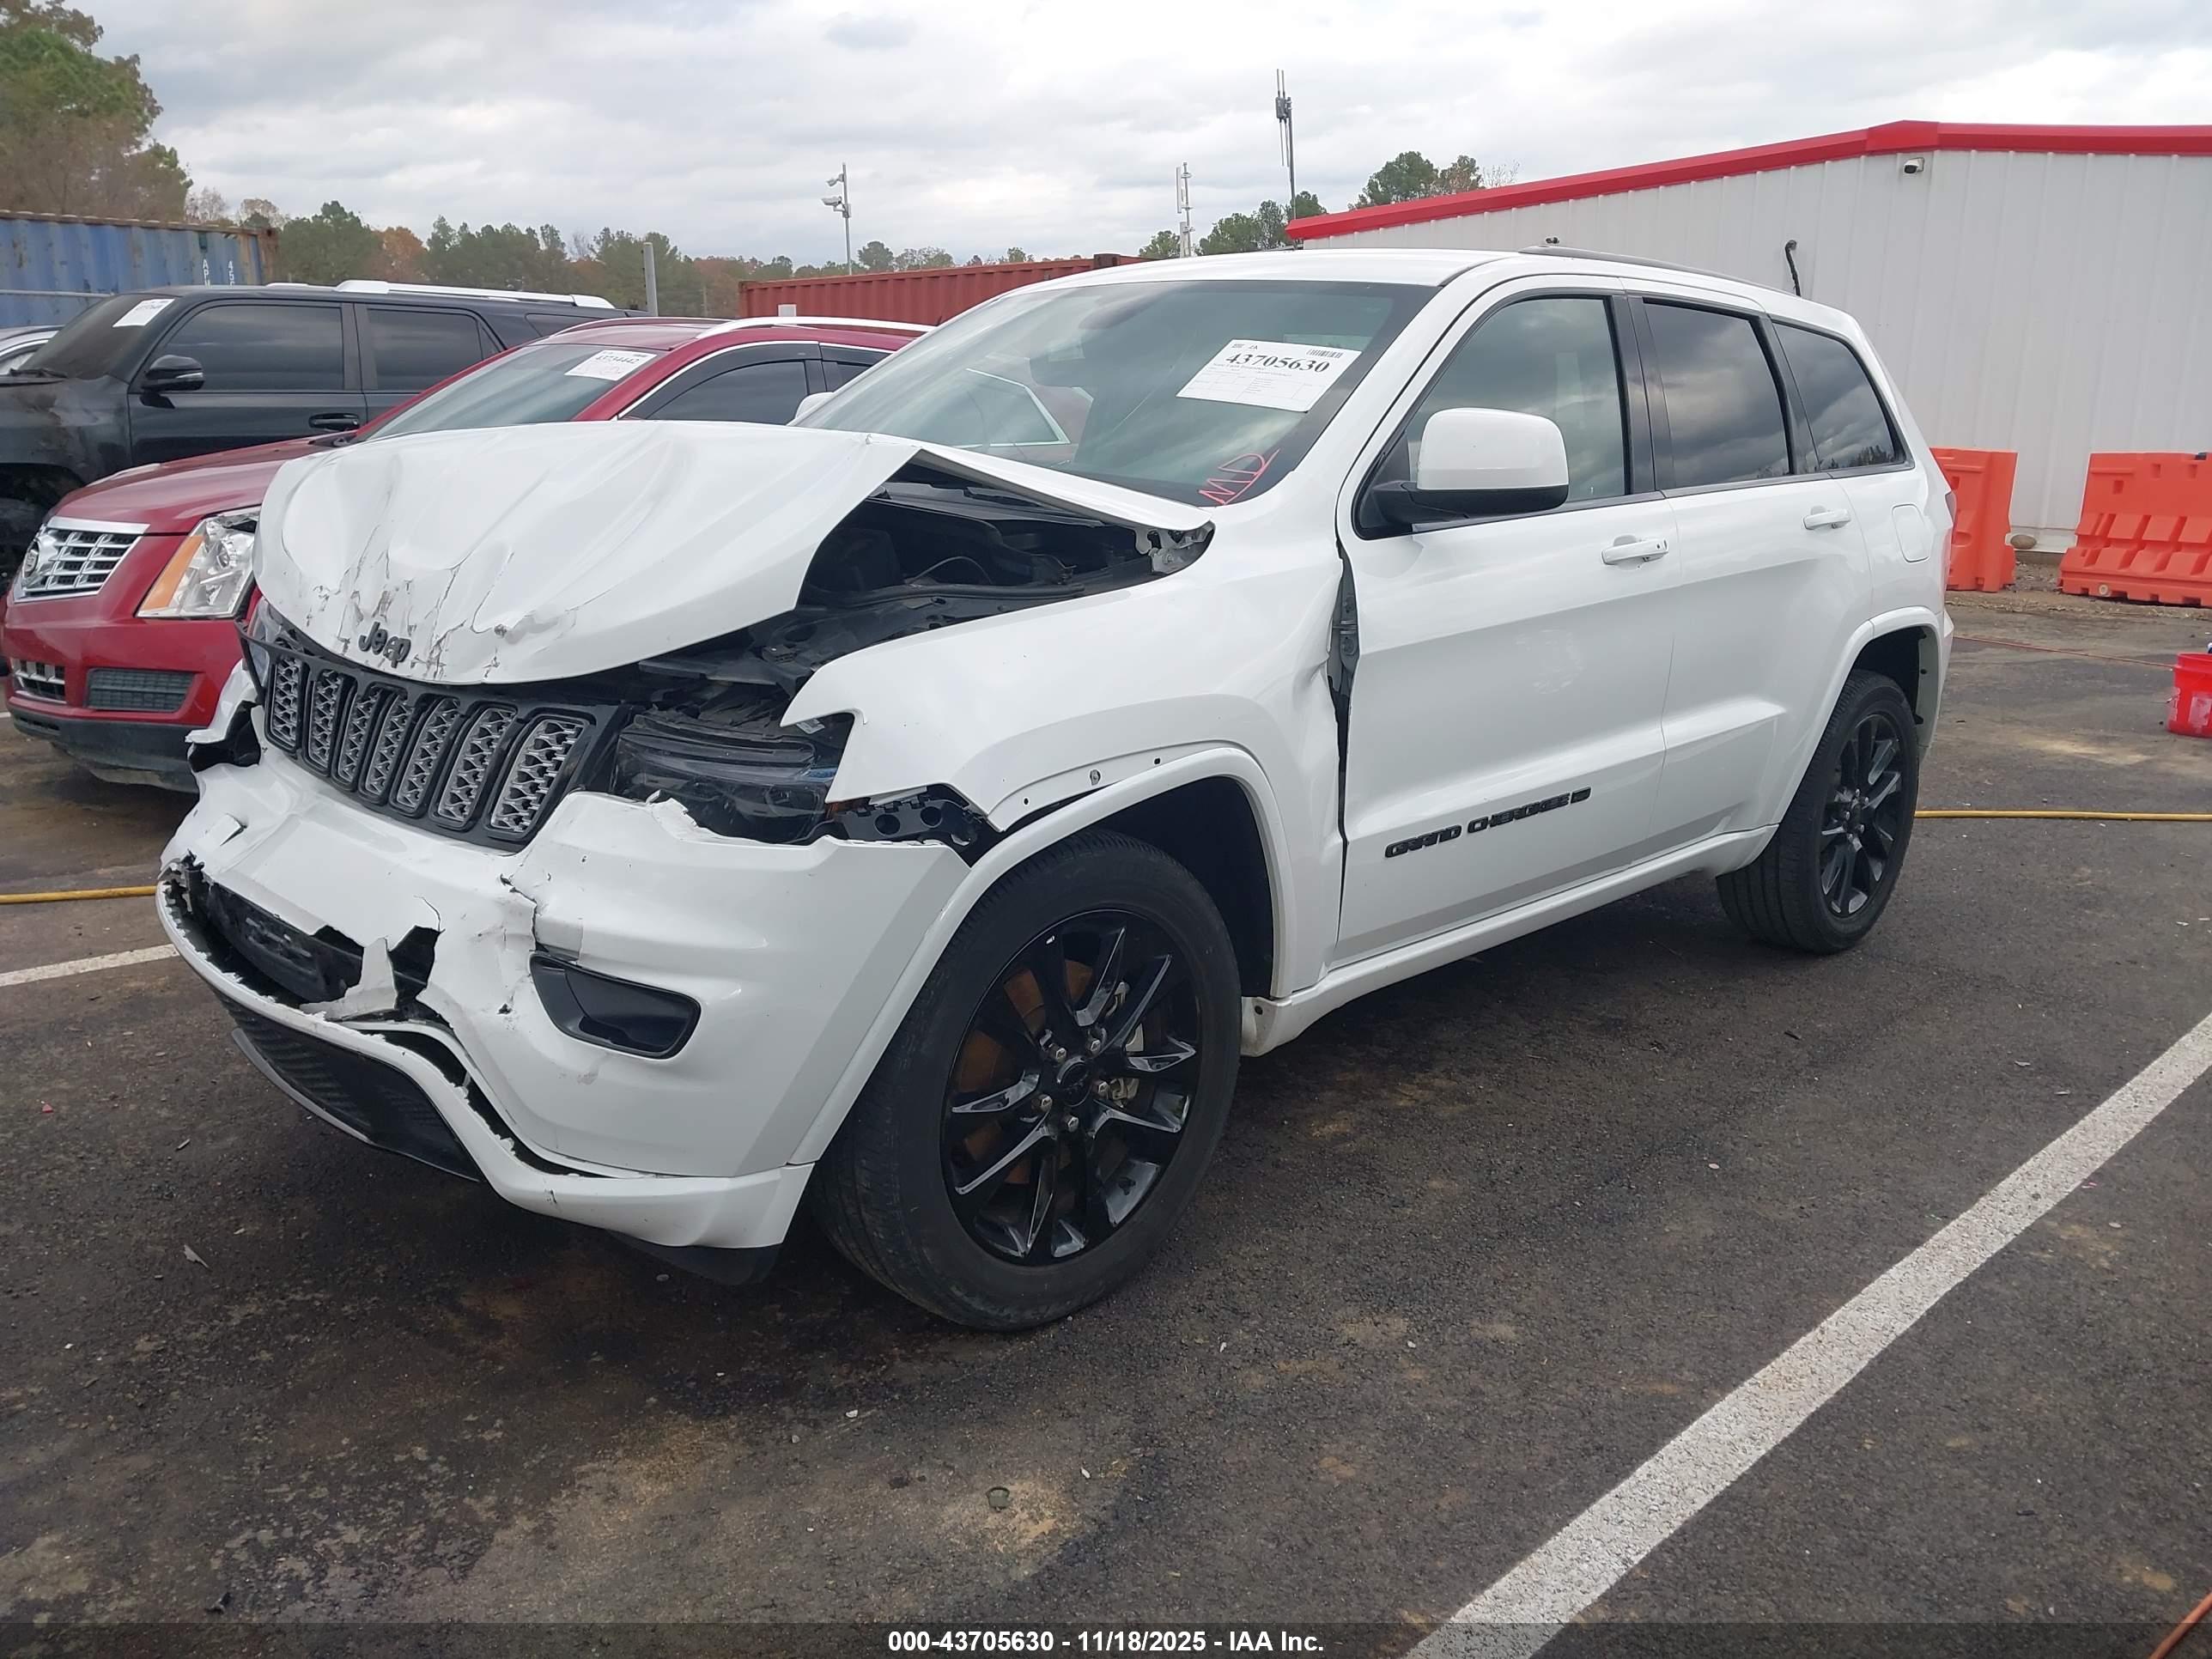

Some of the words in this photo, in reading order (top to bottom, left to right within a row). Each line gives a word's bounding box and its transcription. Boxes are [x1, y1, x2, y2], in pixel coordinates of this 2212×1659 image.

[1225, 352, 1330, 373] 43705630
[358, 621, 411, 669] Jeep
[1384, 824, 1462, 858] GRAND
[1467, 792, 1571, 834] CHEROKEE
